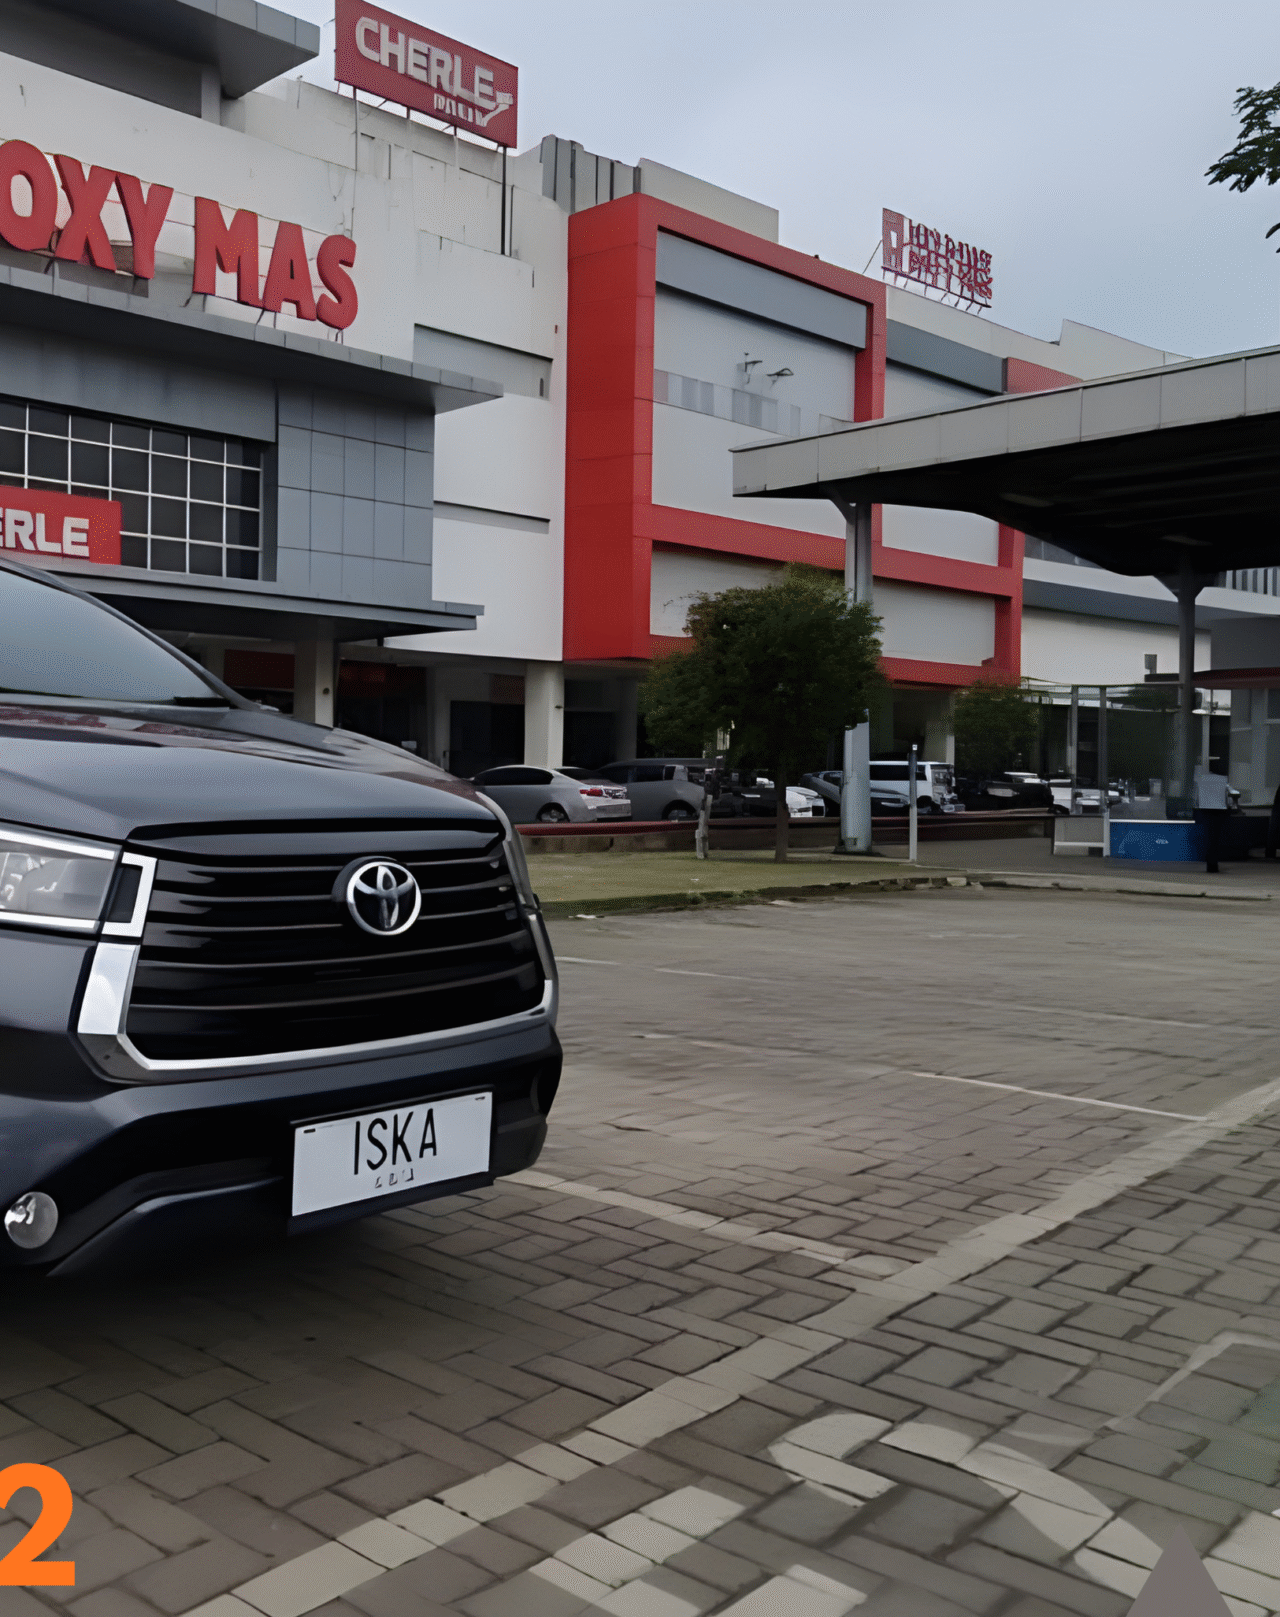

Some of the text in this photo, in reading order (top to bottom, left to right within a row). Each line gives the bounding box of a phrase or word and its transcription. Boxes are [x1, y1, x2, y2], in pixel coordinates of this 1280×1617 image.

[355, 16, 496, 110] CHERLE
[194, 196, 359, 330] MAS
[353, 1107, 437, 1175] ISKA
